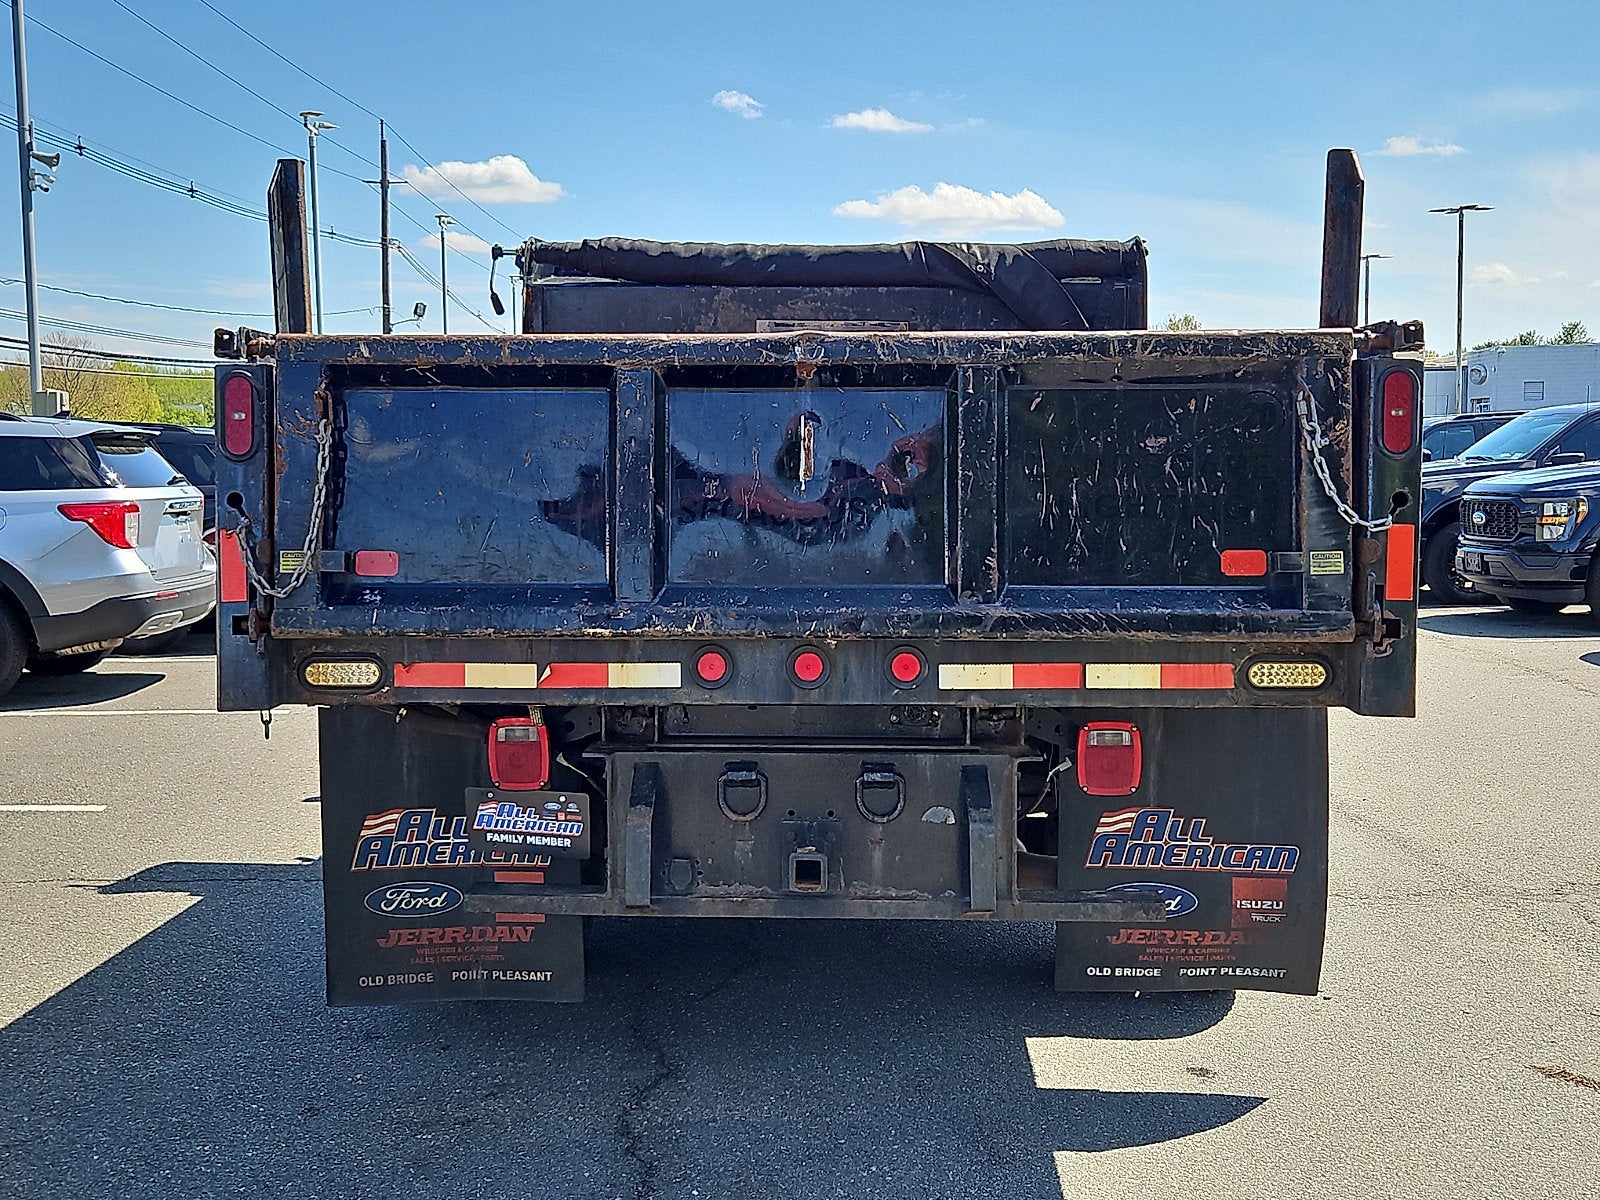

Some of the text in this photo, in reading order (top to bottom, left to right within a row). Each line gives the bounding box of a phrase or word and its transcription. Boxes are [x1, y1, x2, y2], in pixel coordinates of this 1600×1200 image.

[497, 803, 540, 820] ALL
[394, 808, 470, 842] ALL
[473, 813, 583, 837] AMERICAN
[1129, 808, 1214, 843] ALL
[486, 832, 572, 848] FAMILY MEMBER
[1086, 833, 1300, 873] AMERICAN
[380, 887, 449, 911] Ford
[1236, 899, 1283, 910] ISUZU
[1250, 915, 1282, 923] TRUCK
[377, 926, 535, 947] JERR-DAN
[359, 972, 434, 987] OLD BRIDGE
[492, 970, 553, 982] PLEASANT
[1086, 967, 1162, 977] OLD BRIDGE
[1179, 967, 1287, 979] POINT PLEASANT
